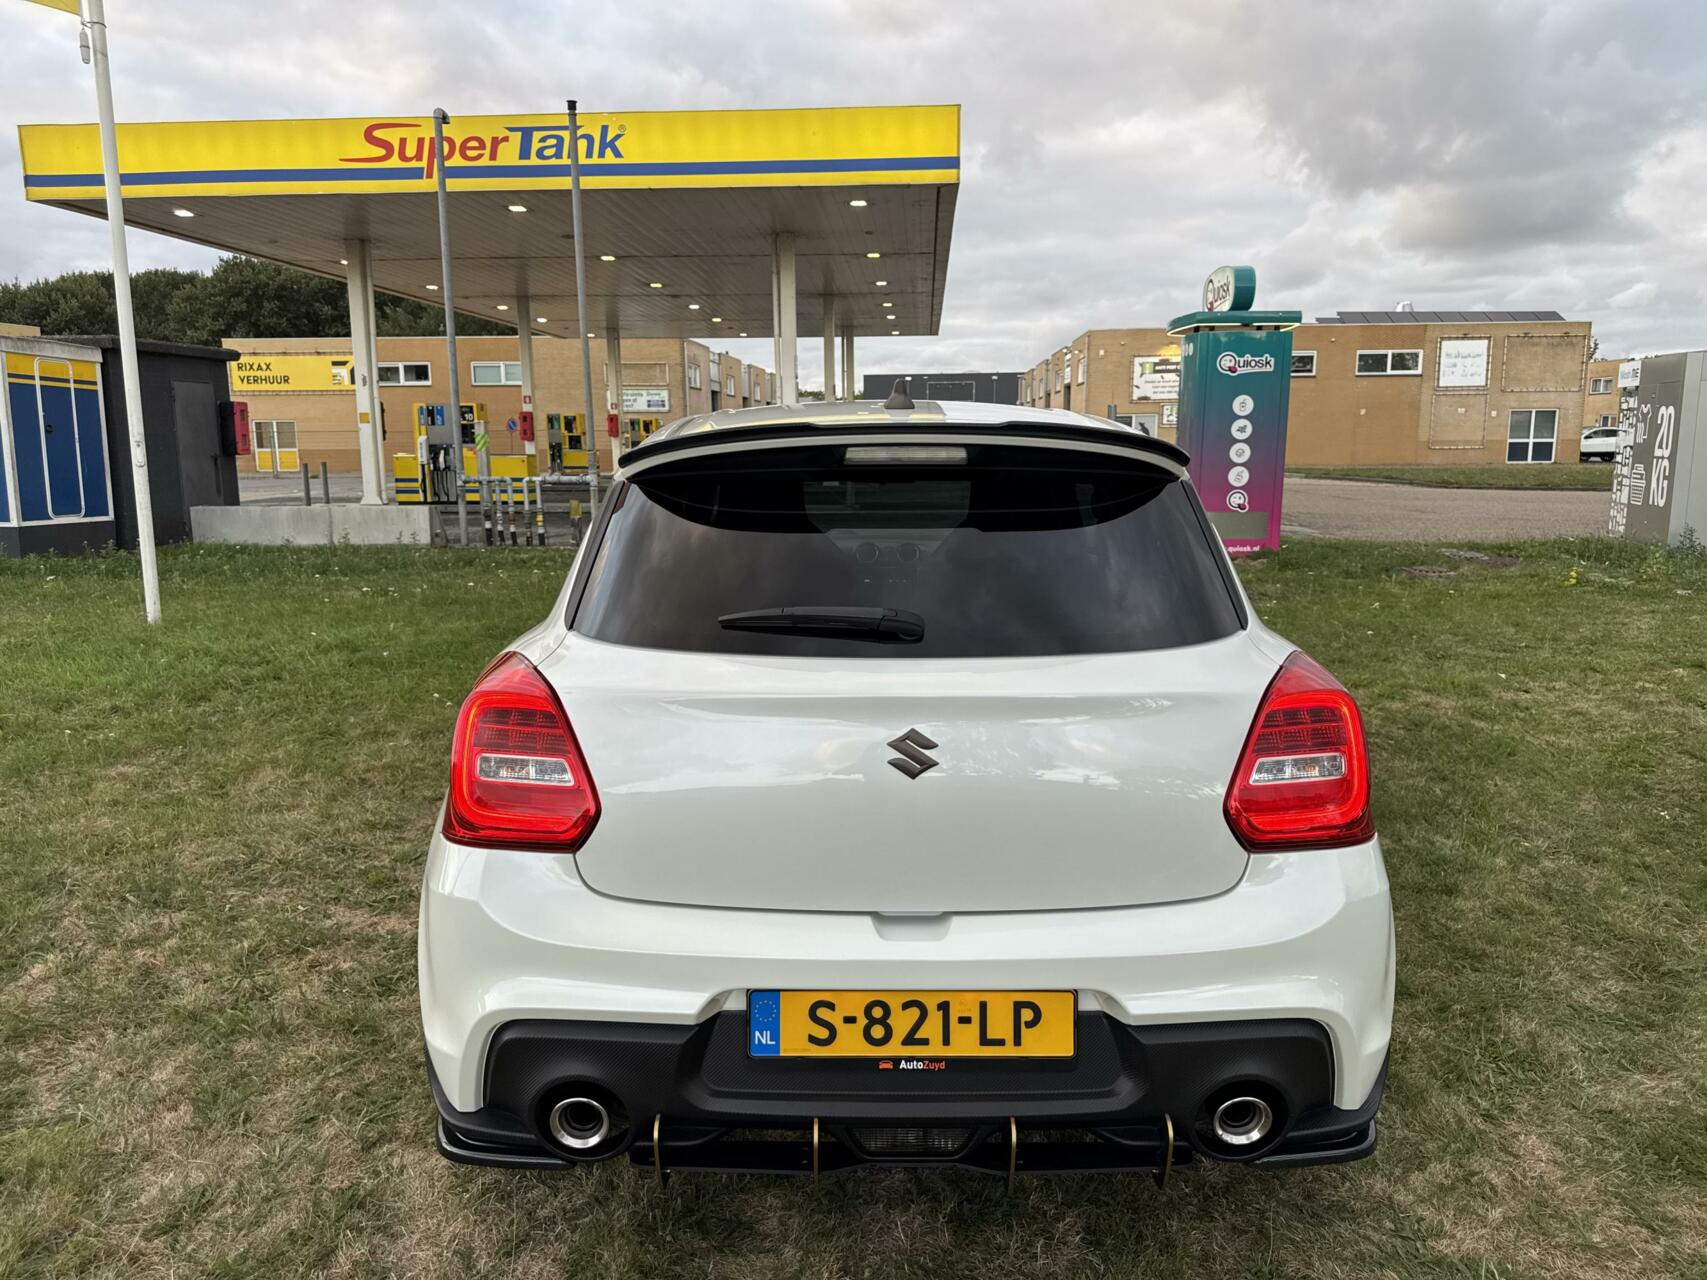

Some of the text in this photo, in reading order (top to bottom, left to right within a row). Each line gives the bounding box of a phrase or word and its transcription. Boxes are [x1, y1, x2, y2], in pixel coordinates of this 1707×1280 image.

[1206, 276, 1231, 311] Quiosk
[237, 362, 272, 372] RIXAX
[1219, 353, 1272, 374] Quiosk
[238, 375, 290, 385] VERHUUR
[1654, 405, 1675, 458] 20
[1648, 458, 1669, 507] KG
[807, 999, 1043, 1047] S-821-LP
[754, 1030, 776, 1045] NL
[899, 1059, 946, 1071] AutoZuyd
